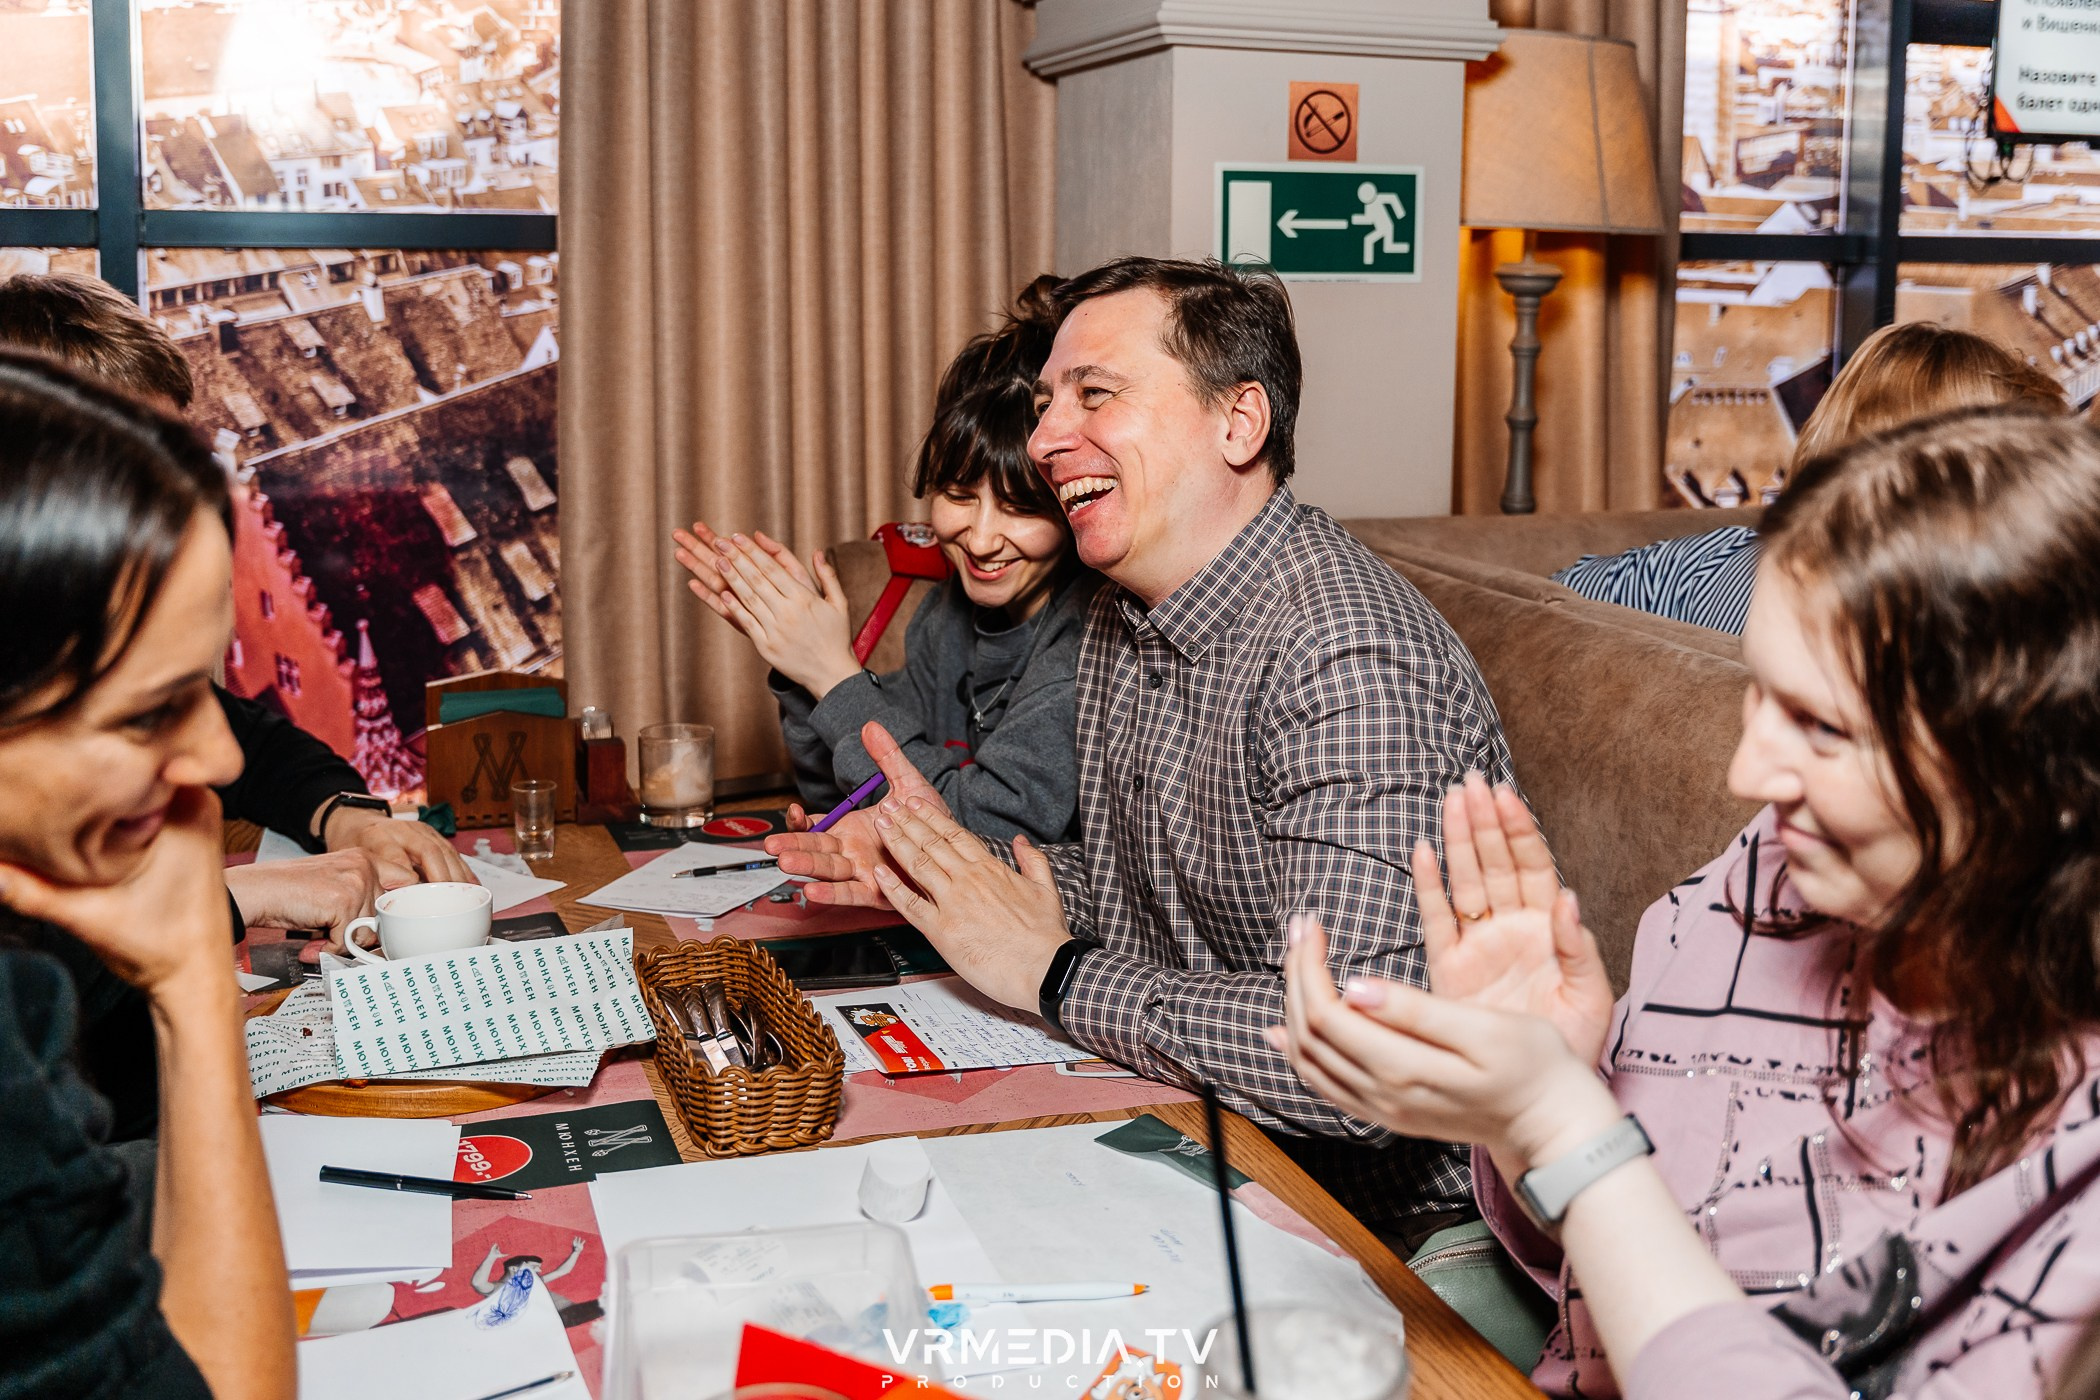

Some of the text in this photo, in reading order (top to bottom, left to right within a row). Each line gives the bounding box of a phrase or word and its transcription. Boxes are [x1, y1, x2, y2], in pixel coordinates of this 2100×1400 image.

[2018, 66, 2097, 86] Назовите
[2016, 92, 2063, 110] балет
[490, 954, 514, 1004] МЮНХЕН
[574, 943, 598, 993] МЮНХЕН
[402, 967, 428, 1020] МЮНХЕН
[464, 1021, 486, 1060] МЮНХ
[611, 998, 635, 1043] МЮНХЕ
[555, 1122, 583, 1172] МЮНХЕН
